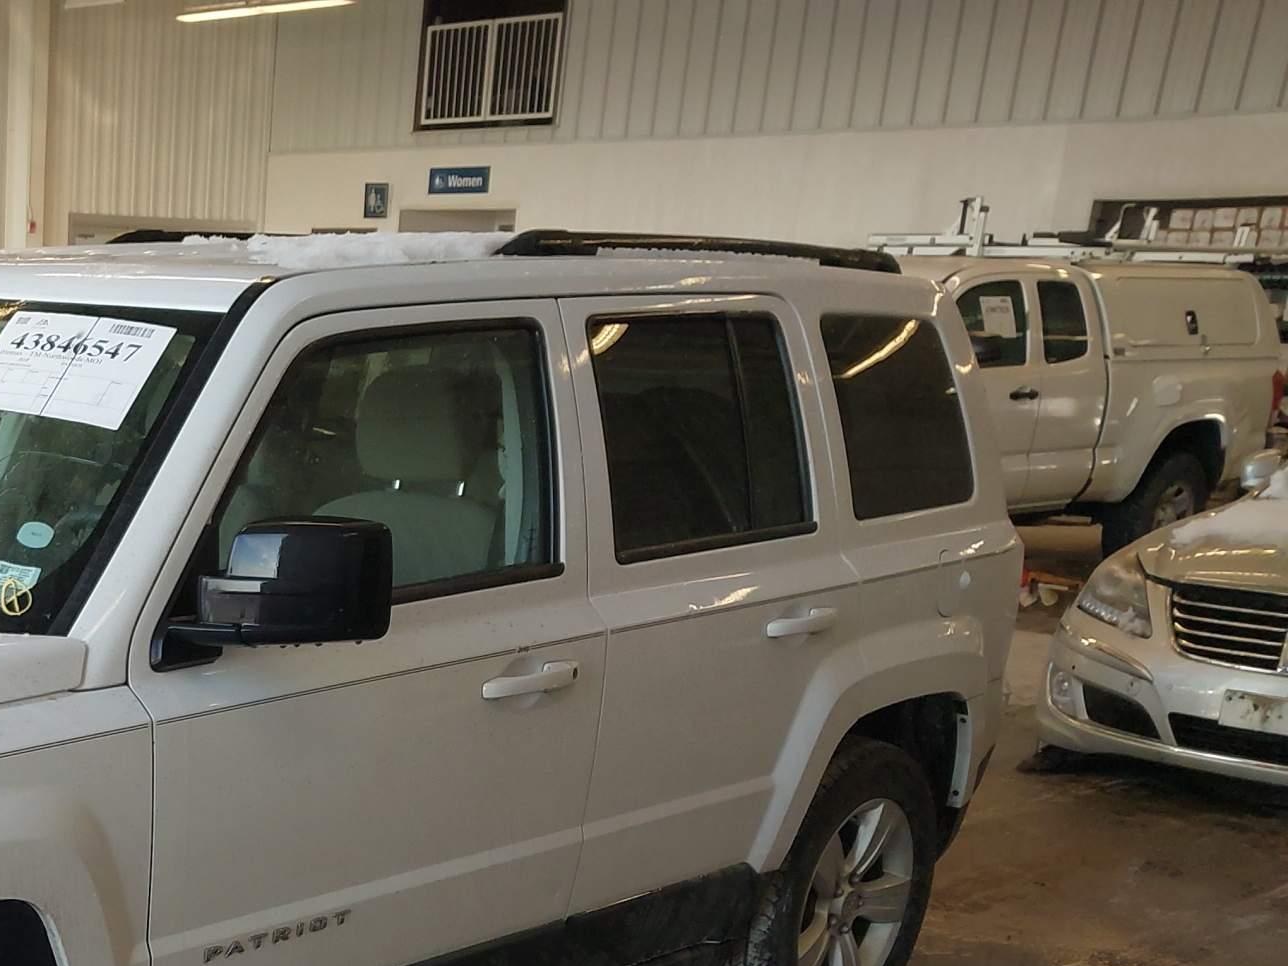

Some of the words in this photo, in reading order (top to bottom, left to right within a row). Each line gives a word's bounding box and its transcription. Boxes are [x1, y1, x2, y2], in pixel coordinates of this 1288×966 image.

[448, 175, 483, 188] Women
[10, 332, 143, 362] 43846547
[203, 909, 352, 964] PATRIOT
